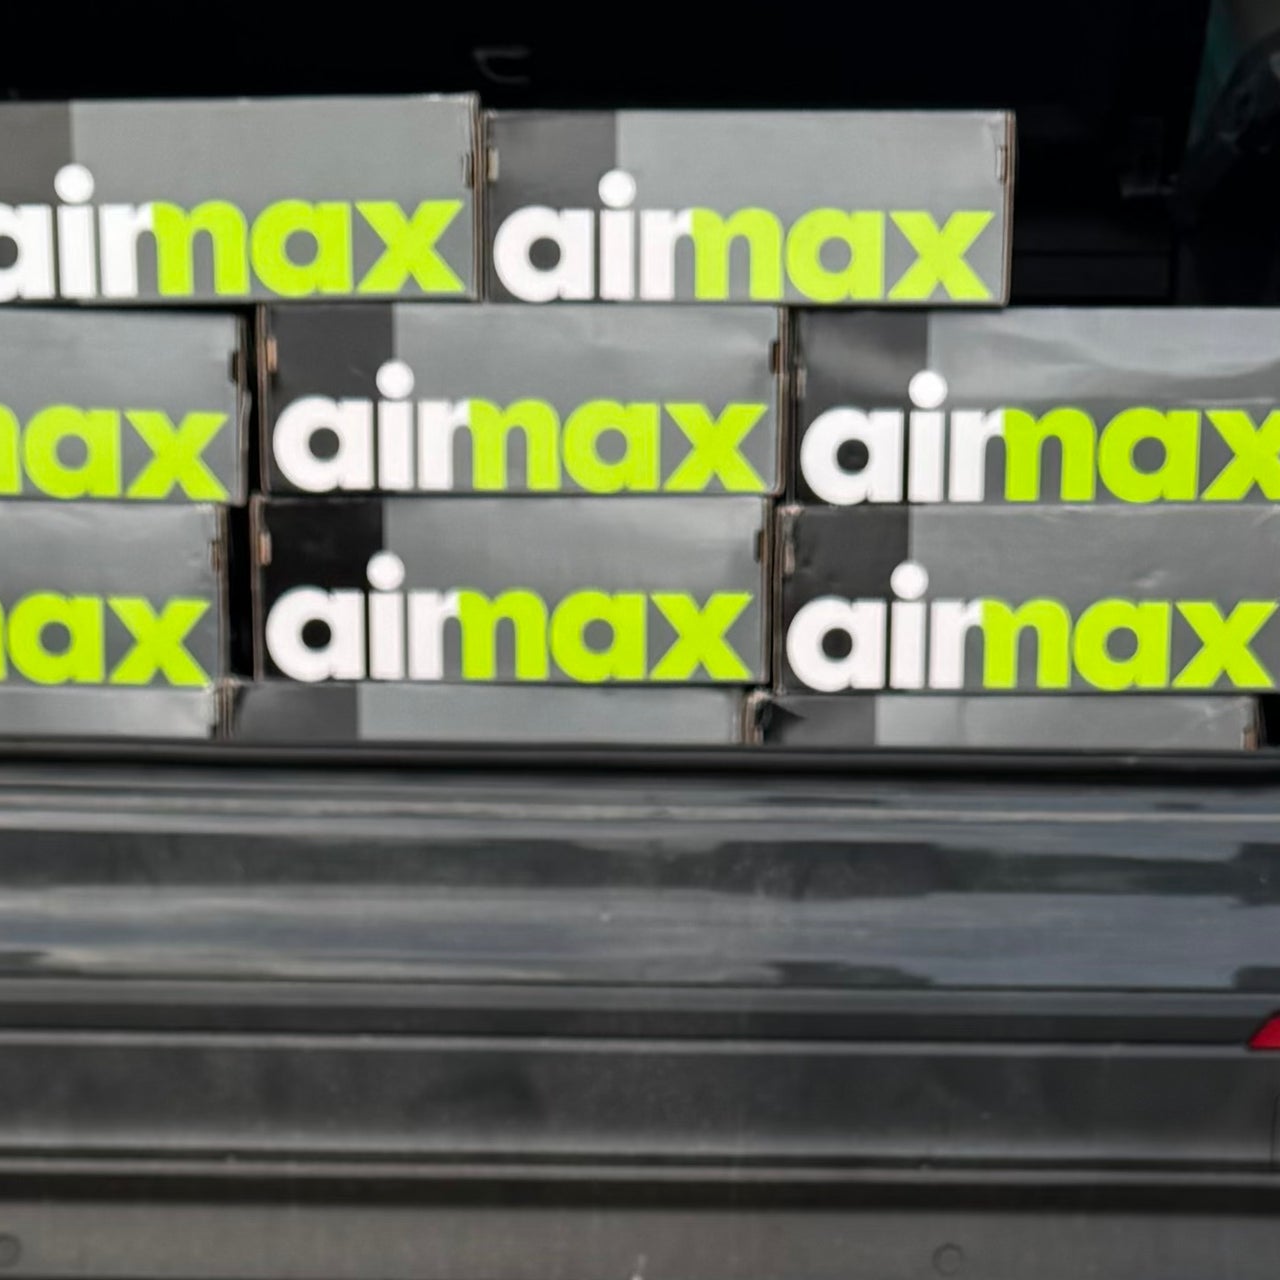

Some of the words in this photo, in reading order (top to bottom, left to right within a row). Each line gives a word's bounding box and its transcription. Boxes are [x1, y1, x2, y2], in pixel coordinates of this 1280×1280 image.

[493, 169, 995, 303] airmax
[272, 360, 768, 492] airmax
[265, 553, 753, 681] airmax
